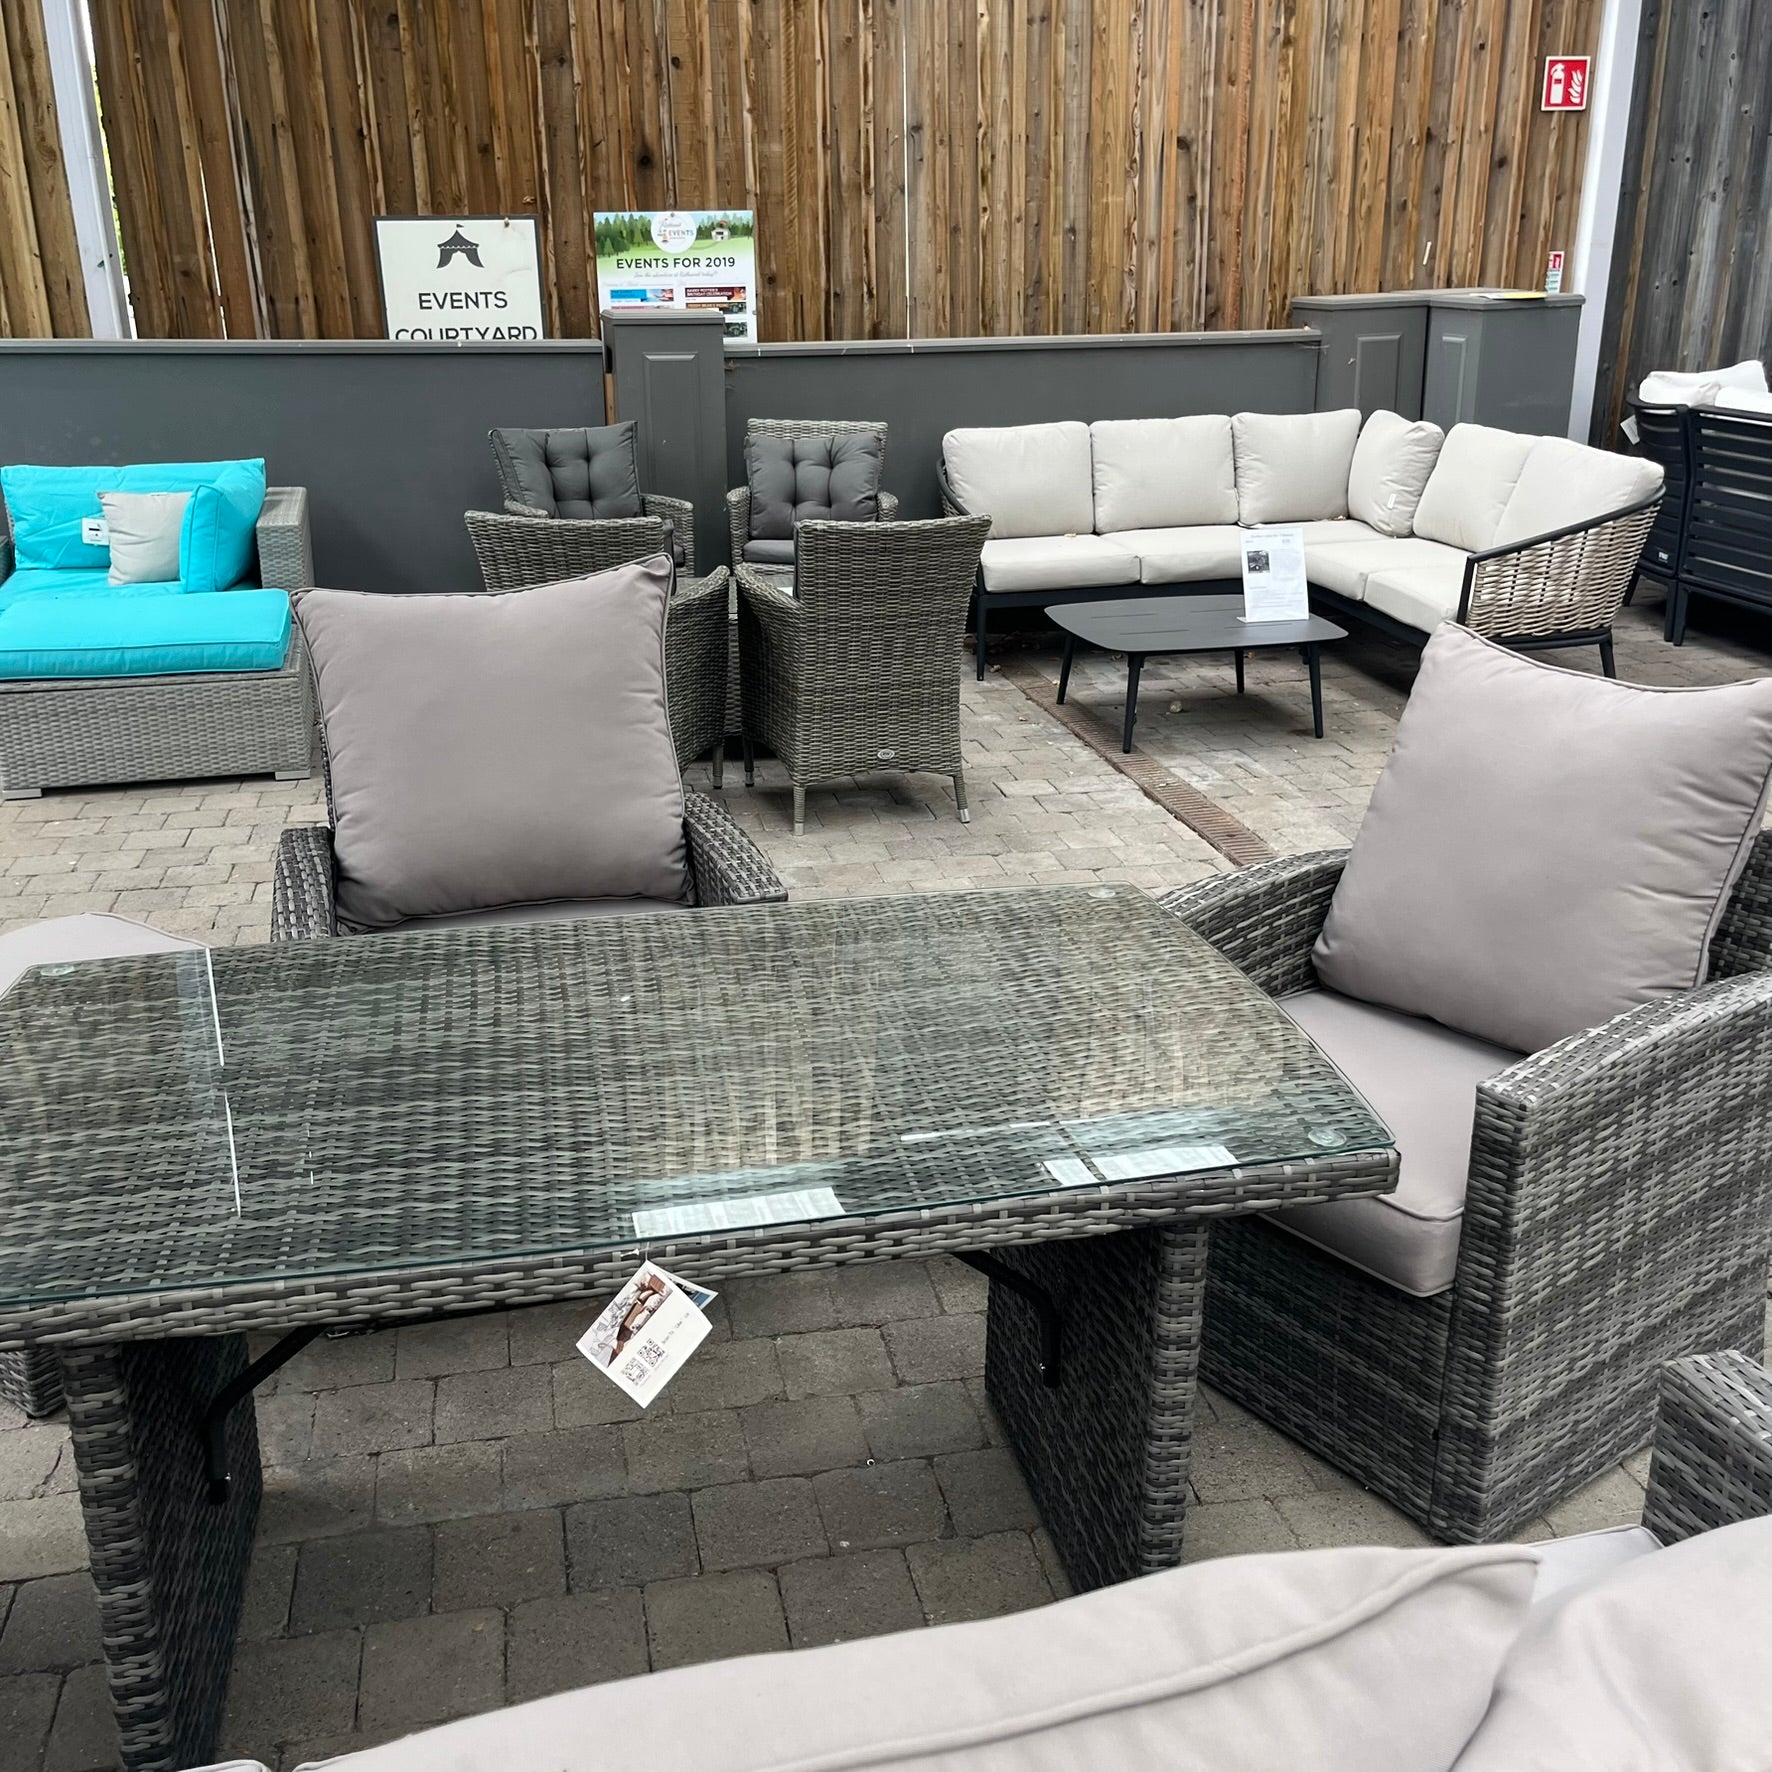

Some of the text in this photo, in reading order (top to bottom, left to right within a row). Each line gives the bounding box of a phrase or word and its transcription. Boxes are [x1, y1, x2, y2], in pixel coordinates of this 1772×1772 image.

[668, 229, 695, 237] EVENTS
[616, 256, 736, 269] EVENTS FOR 2019
[418, 291, 508, 310] EVENTS
[395, 326, 538, 340] COURTYARD
